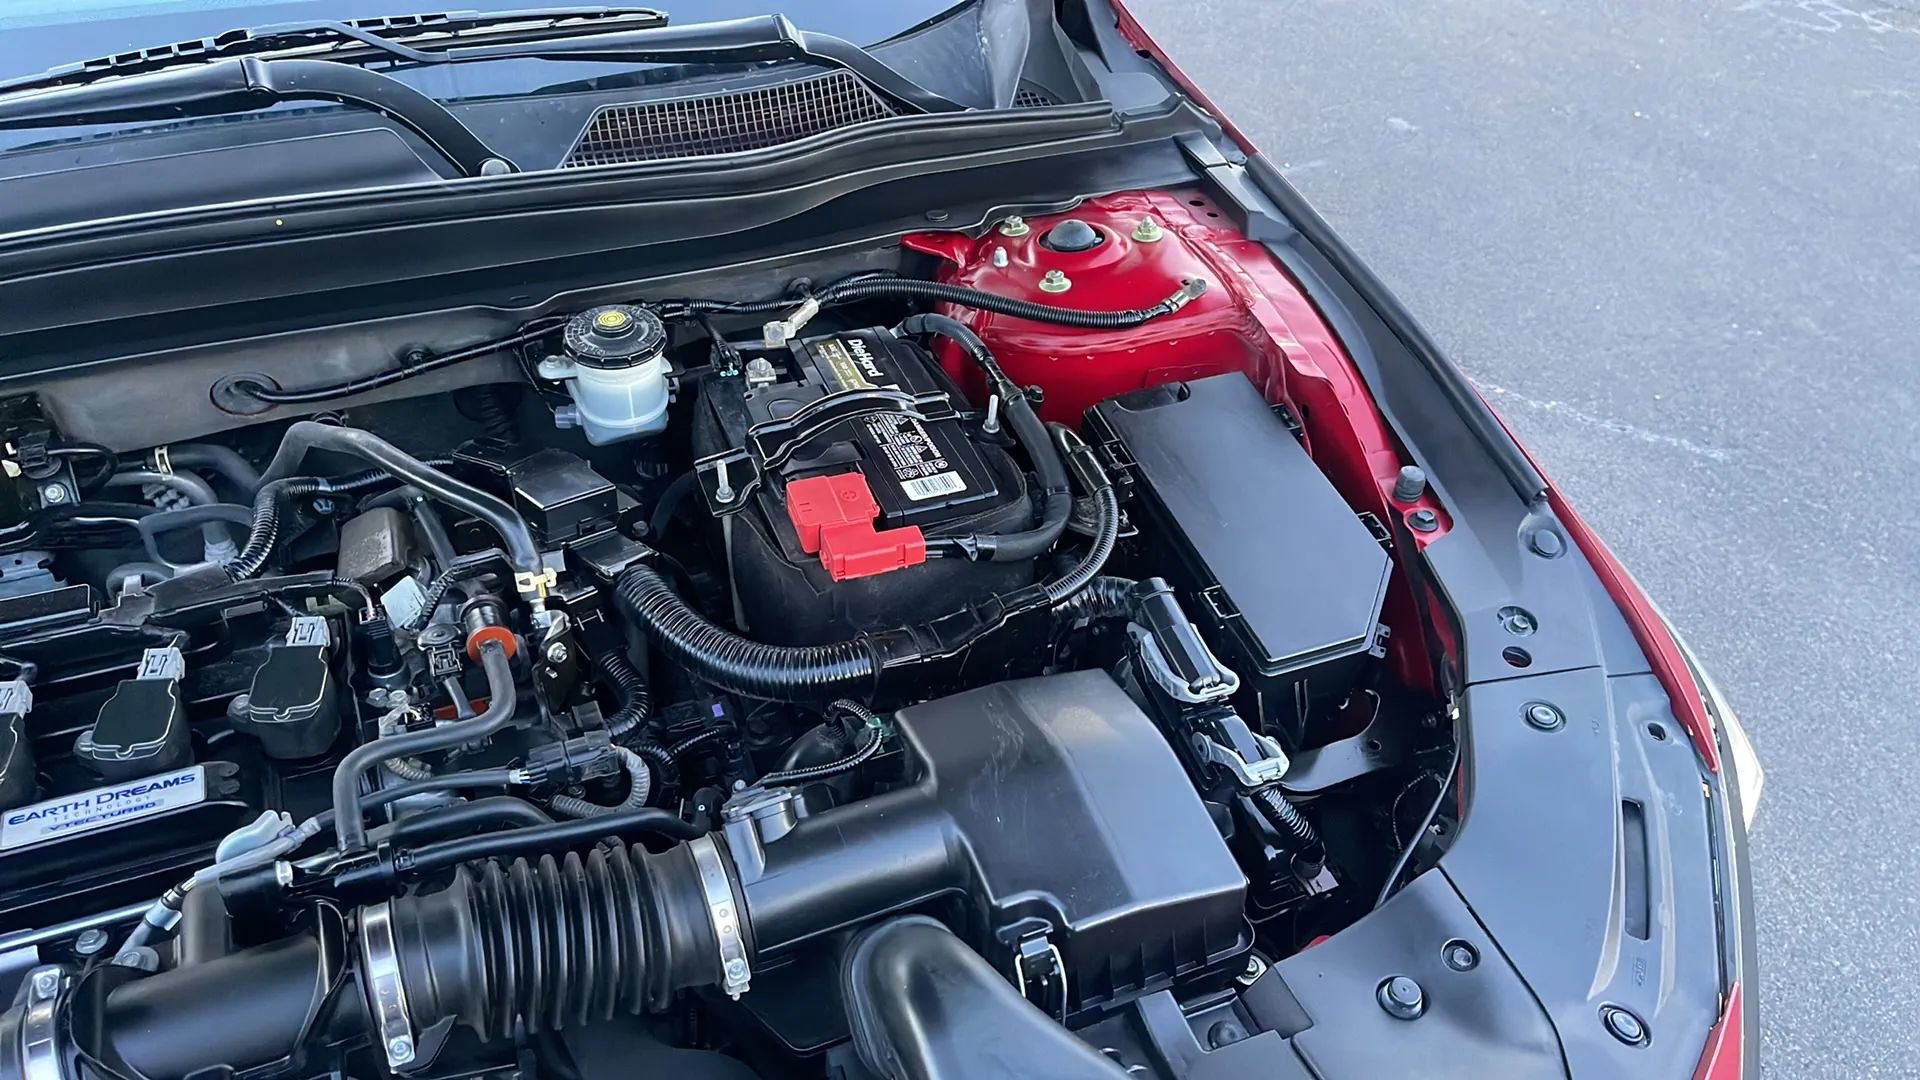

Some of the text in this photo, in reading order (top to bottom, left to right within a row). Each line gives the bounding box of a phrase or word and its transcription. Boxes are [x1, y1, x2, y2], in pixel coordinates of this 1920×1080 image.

[847, 339, 884, 377] DieHard
[8, 773, 195, 826] EARTH DREAMS
[53, 795, 151, 823] TECHNOLOGY
